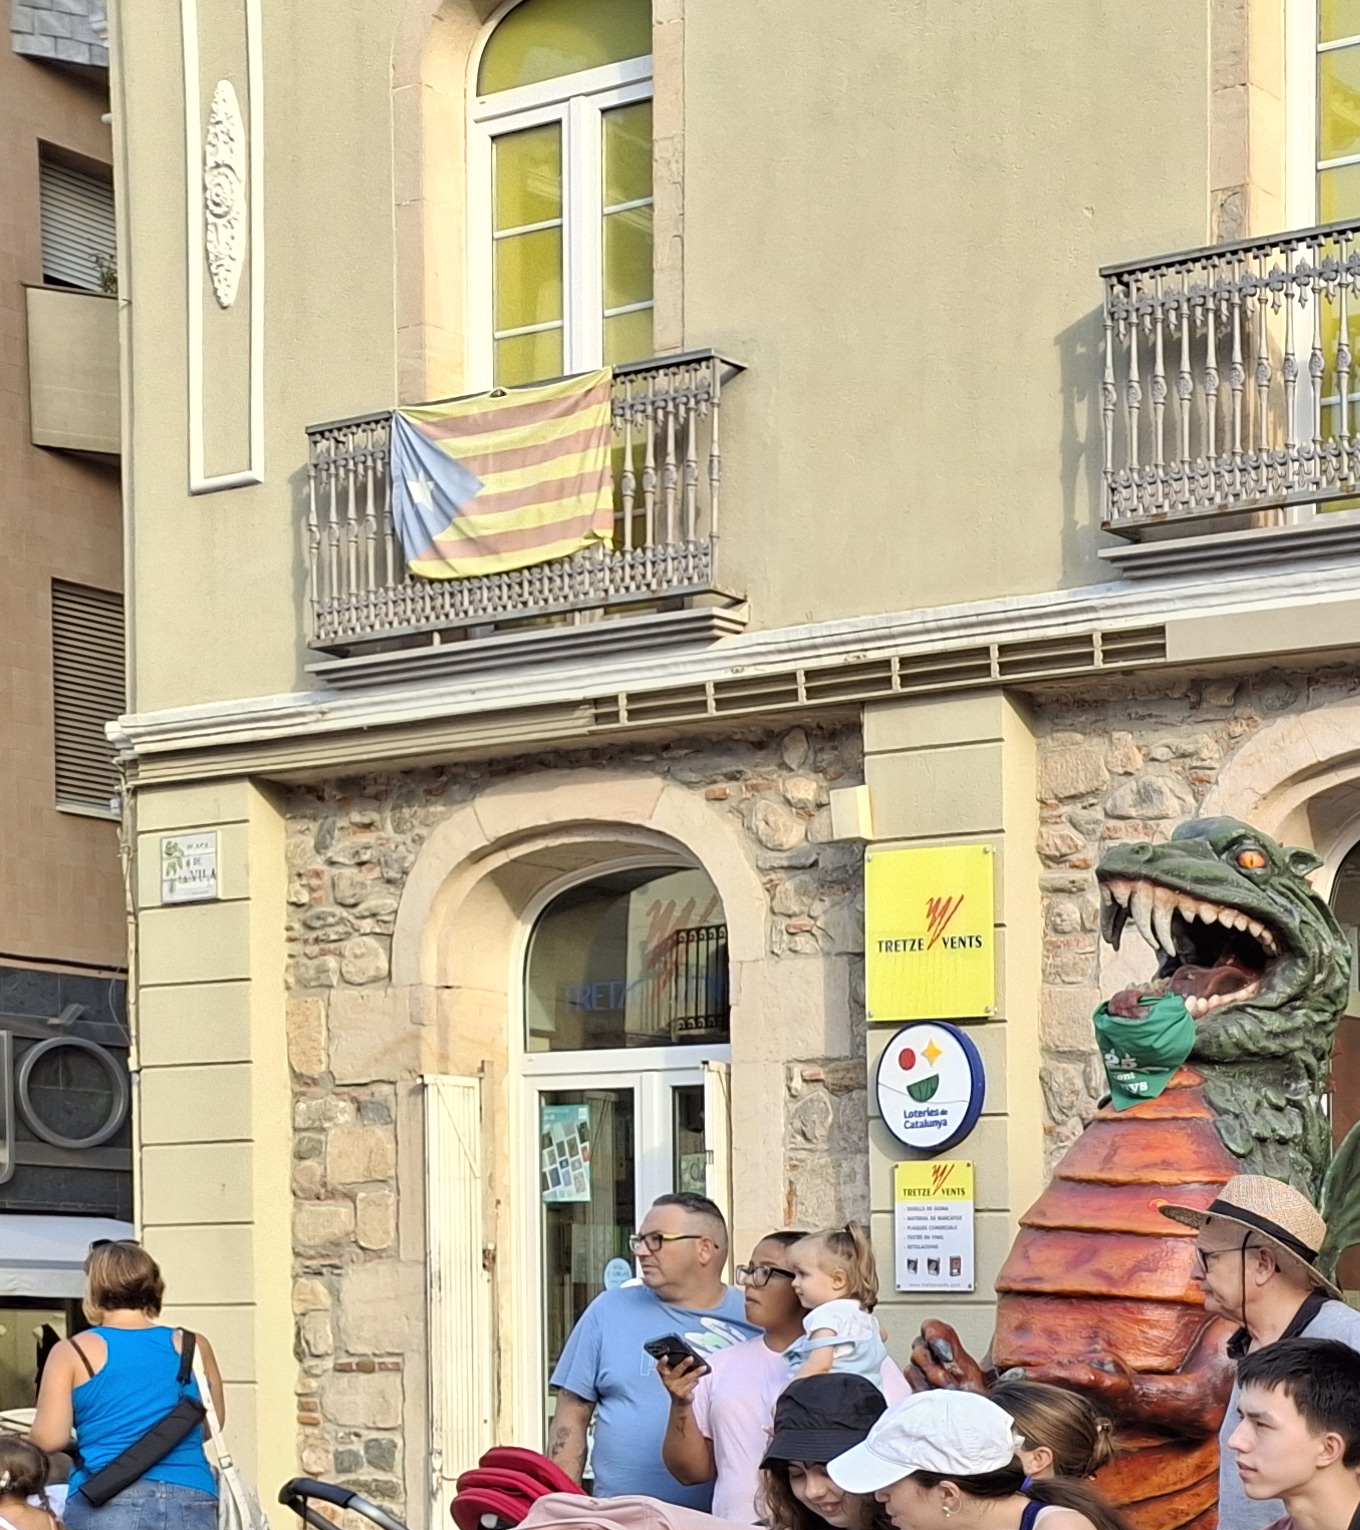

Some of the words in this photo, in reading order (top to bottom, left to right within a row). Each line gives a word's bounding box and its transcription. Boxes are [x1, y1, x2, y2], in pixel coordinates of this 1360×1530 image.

[877, 938, 925, 954] TRETZE
[942, 935, 983, 950] VENTS
[903, 1106, 939, 1119] Loteries
[903, 1118, 948, 1129] Catalunya
[902, 1187, 932, 1197] TRETZE
[941, 1187, 966, 1197] VENTS
